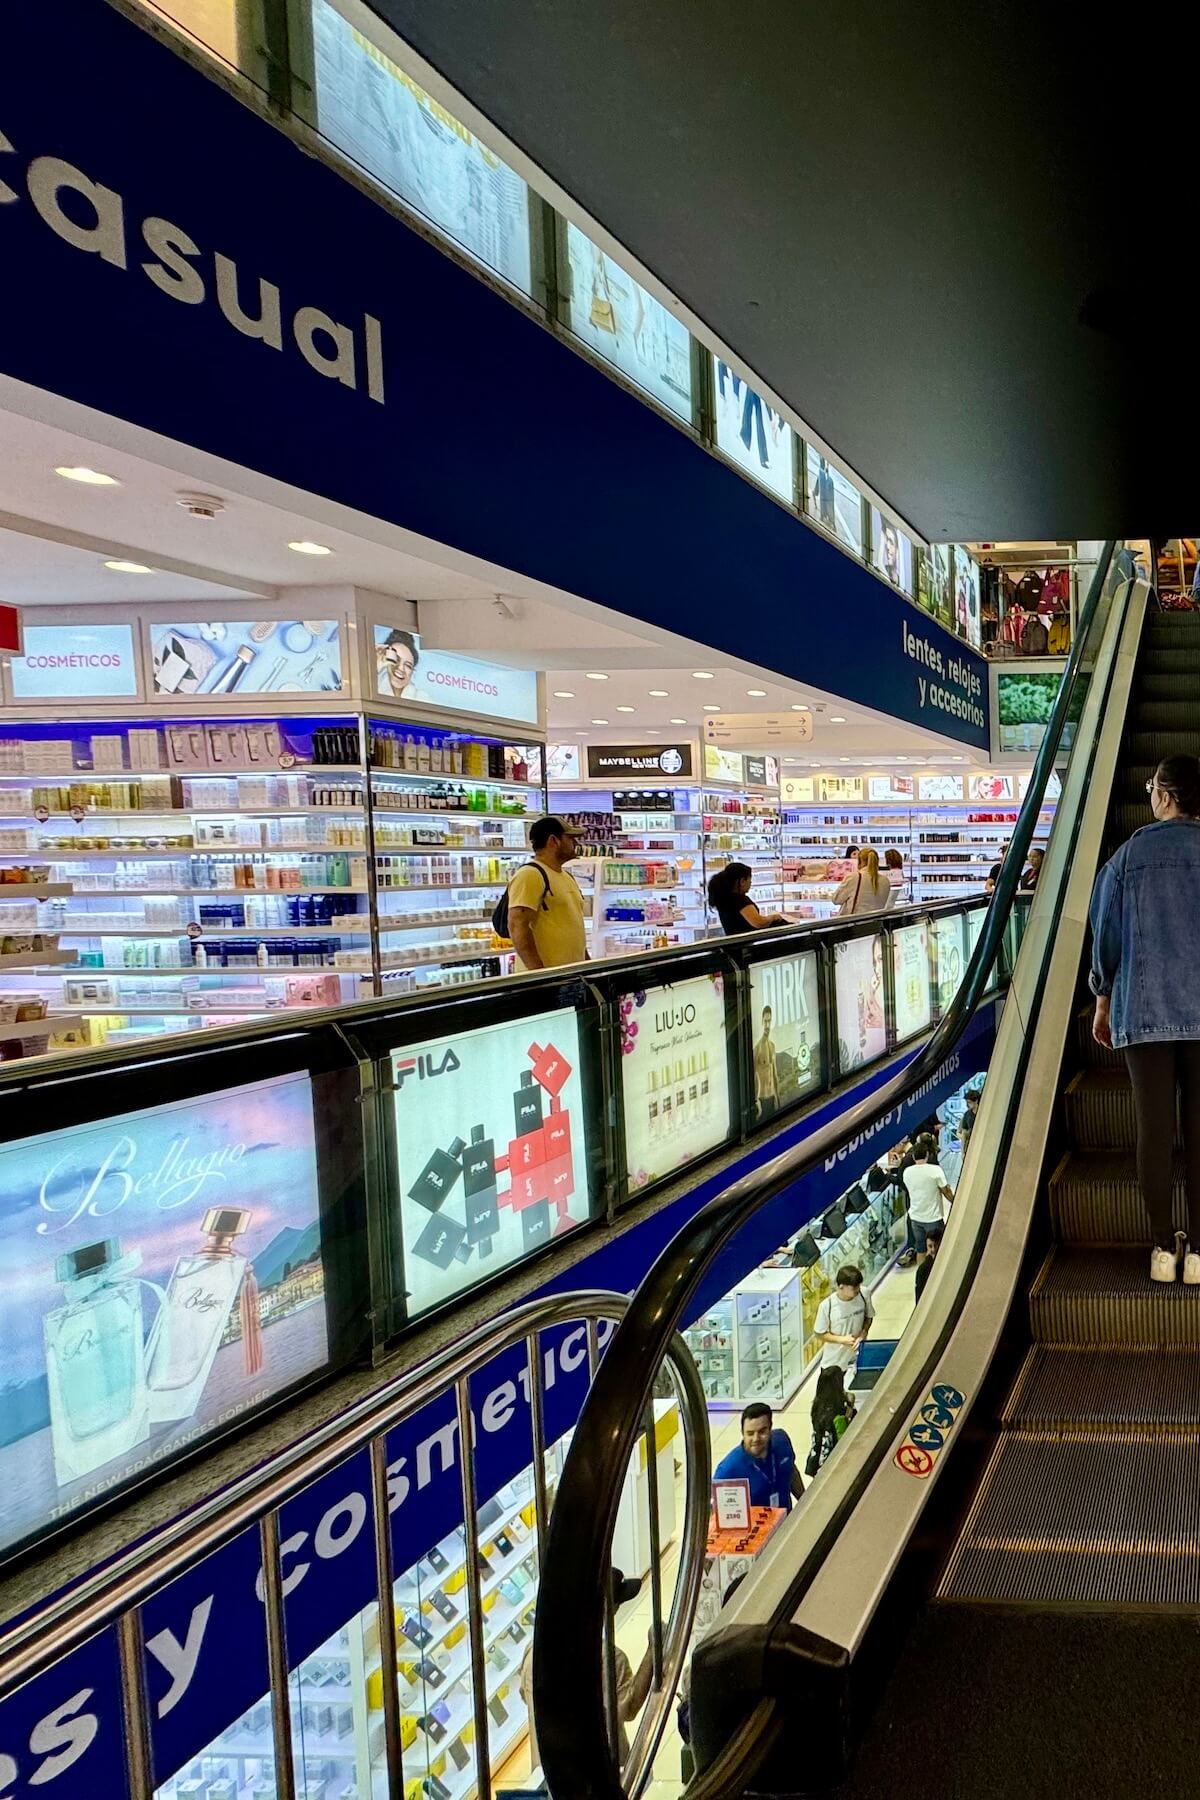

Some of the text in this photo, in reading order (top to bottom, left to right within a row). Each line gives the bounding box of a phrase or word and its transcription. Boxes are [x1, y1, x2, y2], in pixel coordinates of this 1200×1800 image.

[0, 130, 385, 405] asual
[27, 652, 121, 669] COSMÉTICOS
[426, 671, 499, 697] COSMÉTICOS
[903, 620, 981, 697] lentes, relojes
[918, 677, 984, 728] y accesorios
[599, 757, 660, 766] MAYBELLINE
[762, 958, 809, 1027] DIRK
[396, 1048, 461, 1088] FILA
[520, 1103, 536, 1115] FILA
[36, 1135, 247, 1235] Bellagio
[426, 1170, 444, 1188] FILA
[470, 1160, 489, 1174] FILA
[47, 1388, 271, 1521] THE NEW FRAGRANCES FOR HER
[255, 1289, 636, 1604] cosmetico
[145, 1593, 215, 1720] y
